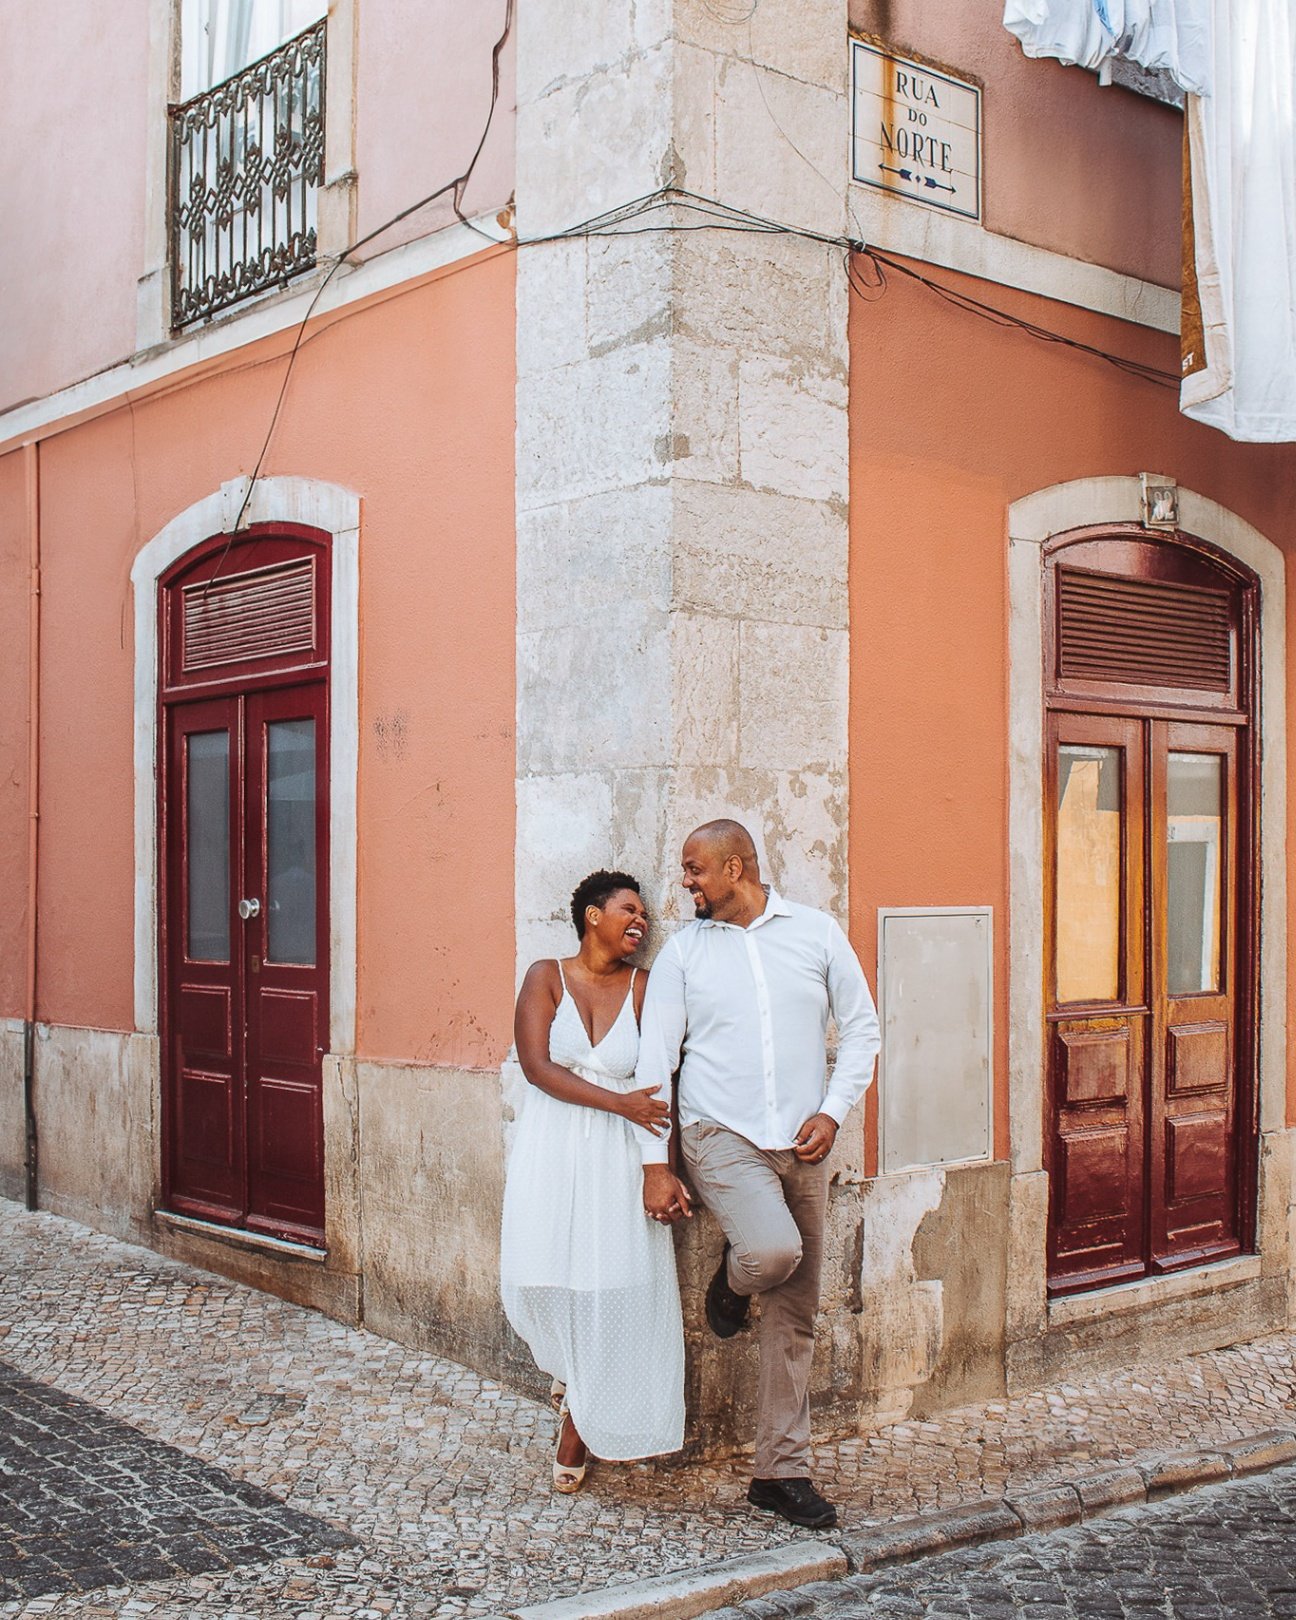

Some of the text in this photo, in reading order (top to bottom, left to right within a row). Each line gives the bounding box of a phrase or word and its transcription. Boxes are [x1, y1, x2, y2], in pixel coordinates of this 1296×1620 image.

[896, 71, 940, 108] RUA
[908, 108, 927, 127] DO
[880, 121, 953, 173] NORTE
